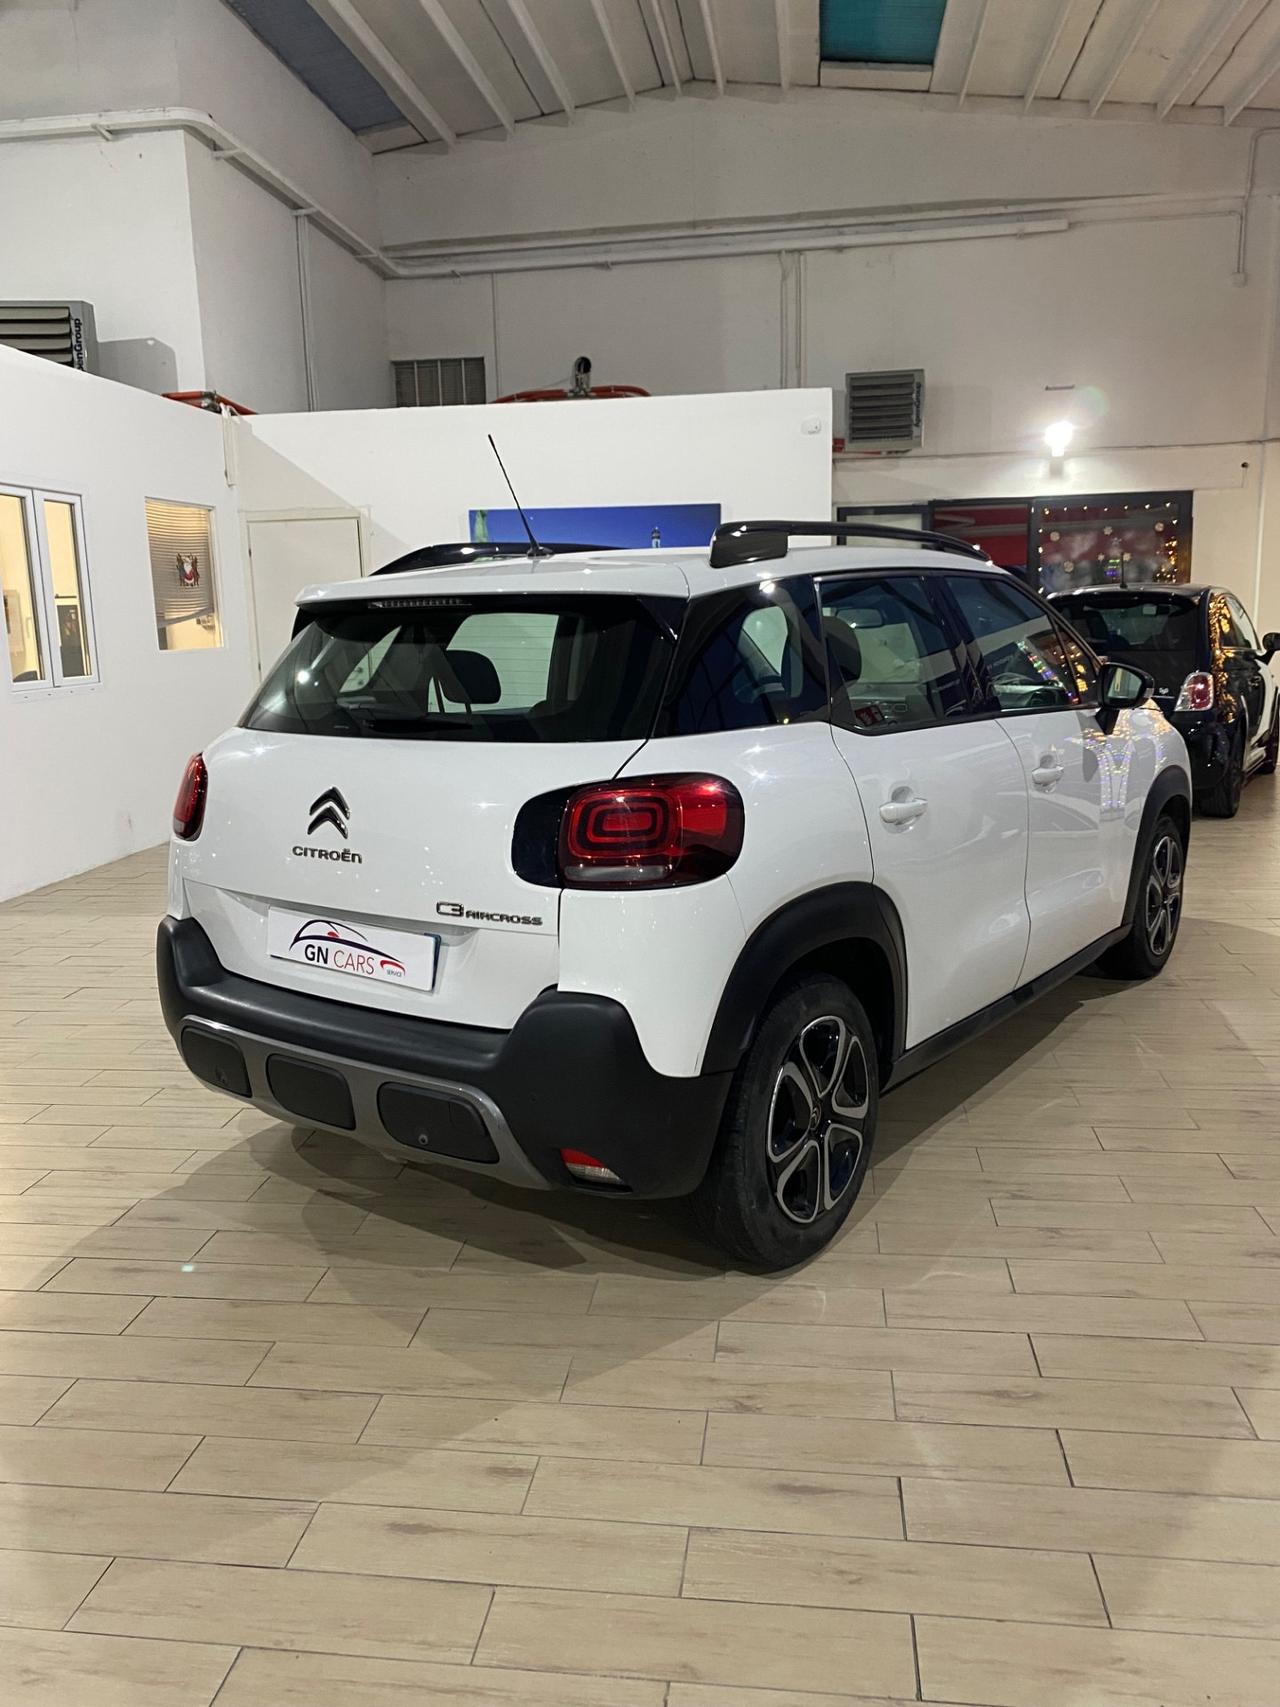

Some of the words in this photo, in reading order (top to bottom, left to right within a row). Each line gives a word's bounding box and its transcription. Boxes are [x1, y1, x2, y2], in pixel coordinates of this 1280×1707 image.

[436, 902, 464, 917] C3
[465, 910, 543, 926] AIRCROSS
[304, 943, 329, 965] GN
[333, 950, 375, 975] CARS
